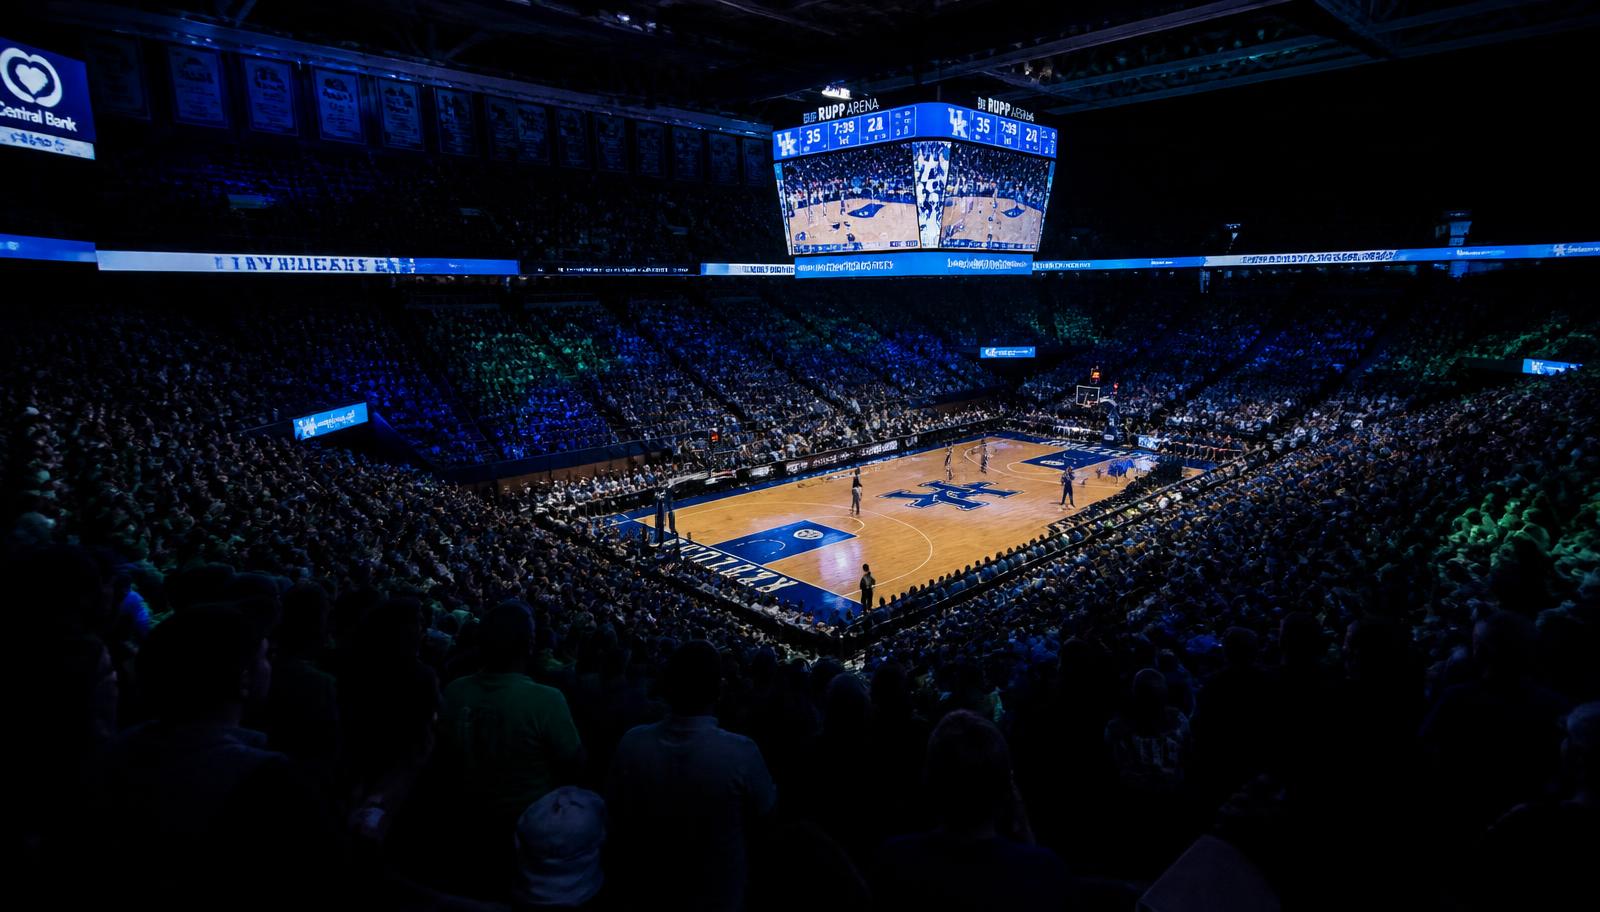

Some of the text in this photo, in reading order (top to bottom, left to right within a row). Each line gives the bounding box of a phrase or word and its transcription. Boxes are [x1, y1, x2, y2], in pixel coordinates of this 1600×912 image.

[818, 103, 845, 121] RUPP
[846, 98, 880, 115] ARENA
[988, 97, 1011, 117] RUPP
[45, 111, 77, 132] Bank
[976, 117, 991, 134] 35
[806, 128, 821, 144] 35
